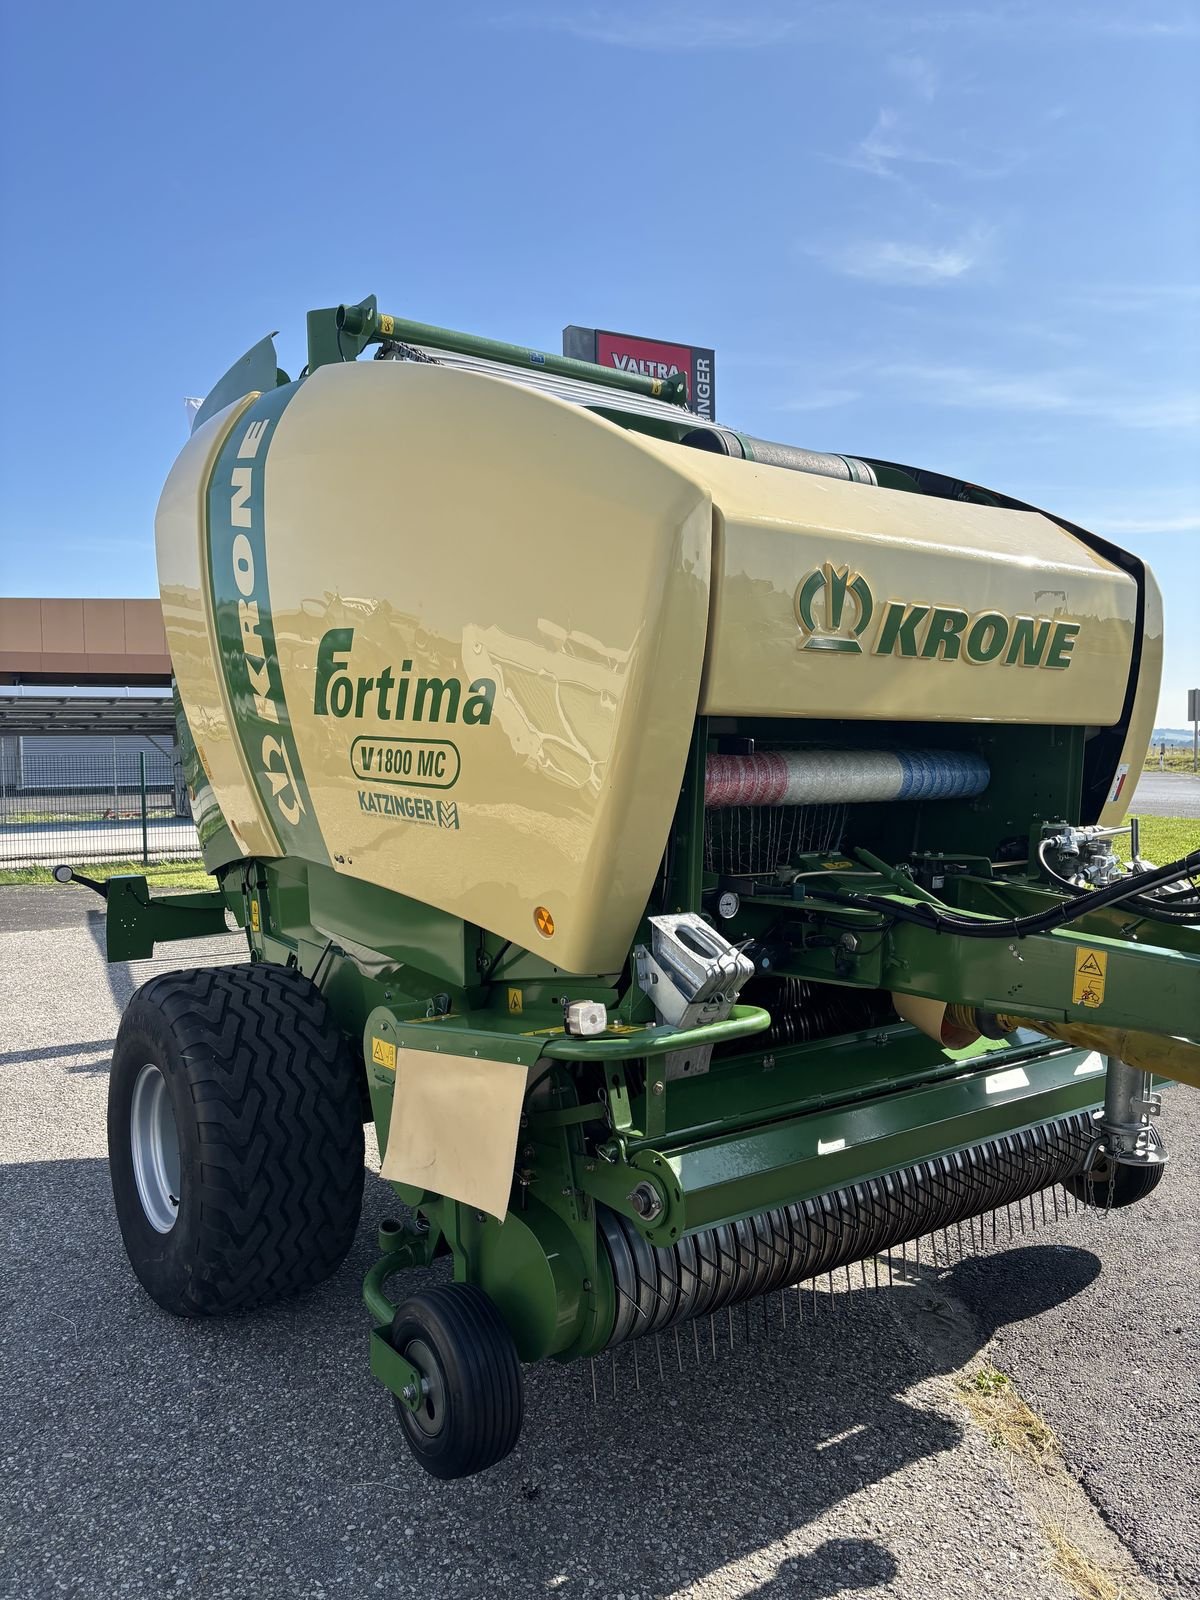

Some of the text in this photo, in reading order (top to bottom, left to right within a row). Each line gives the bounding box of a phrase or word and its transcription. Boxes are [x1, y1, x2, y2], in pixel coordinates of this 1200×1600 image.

[612, 352, 679, 379] VALTRA
[231, 419, 280, 724] KRONE
[872, 600, 1081, 670] KRONE
[313, 627, 497, 726] Fortima
[417, 750, 447, 779] MC
[357, 790, 436, 821] KATZINGER
